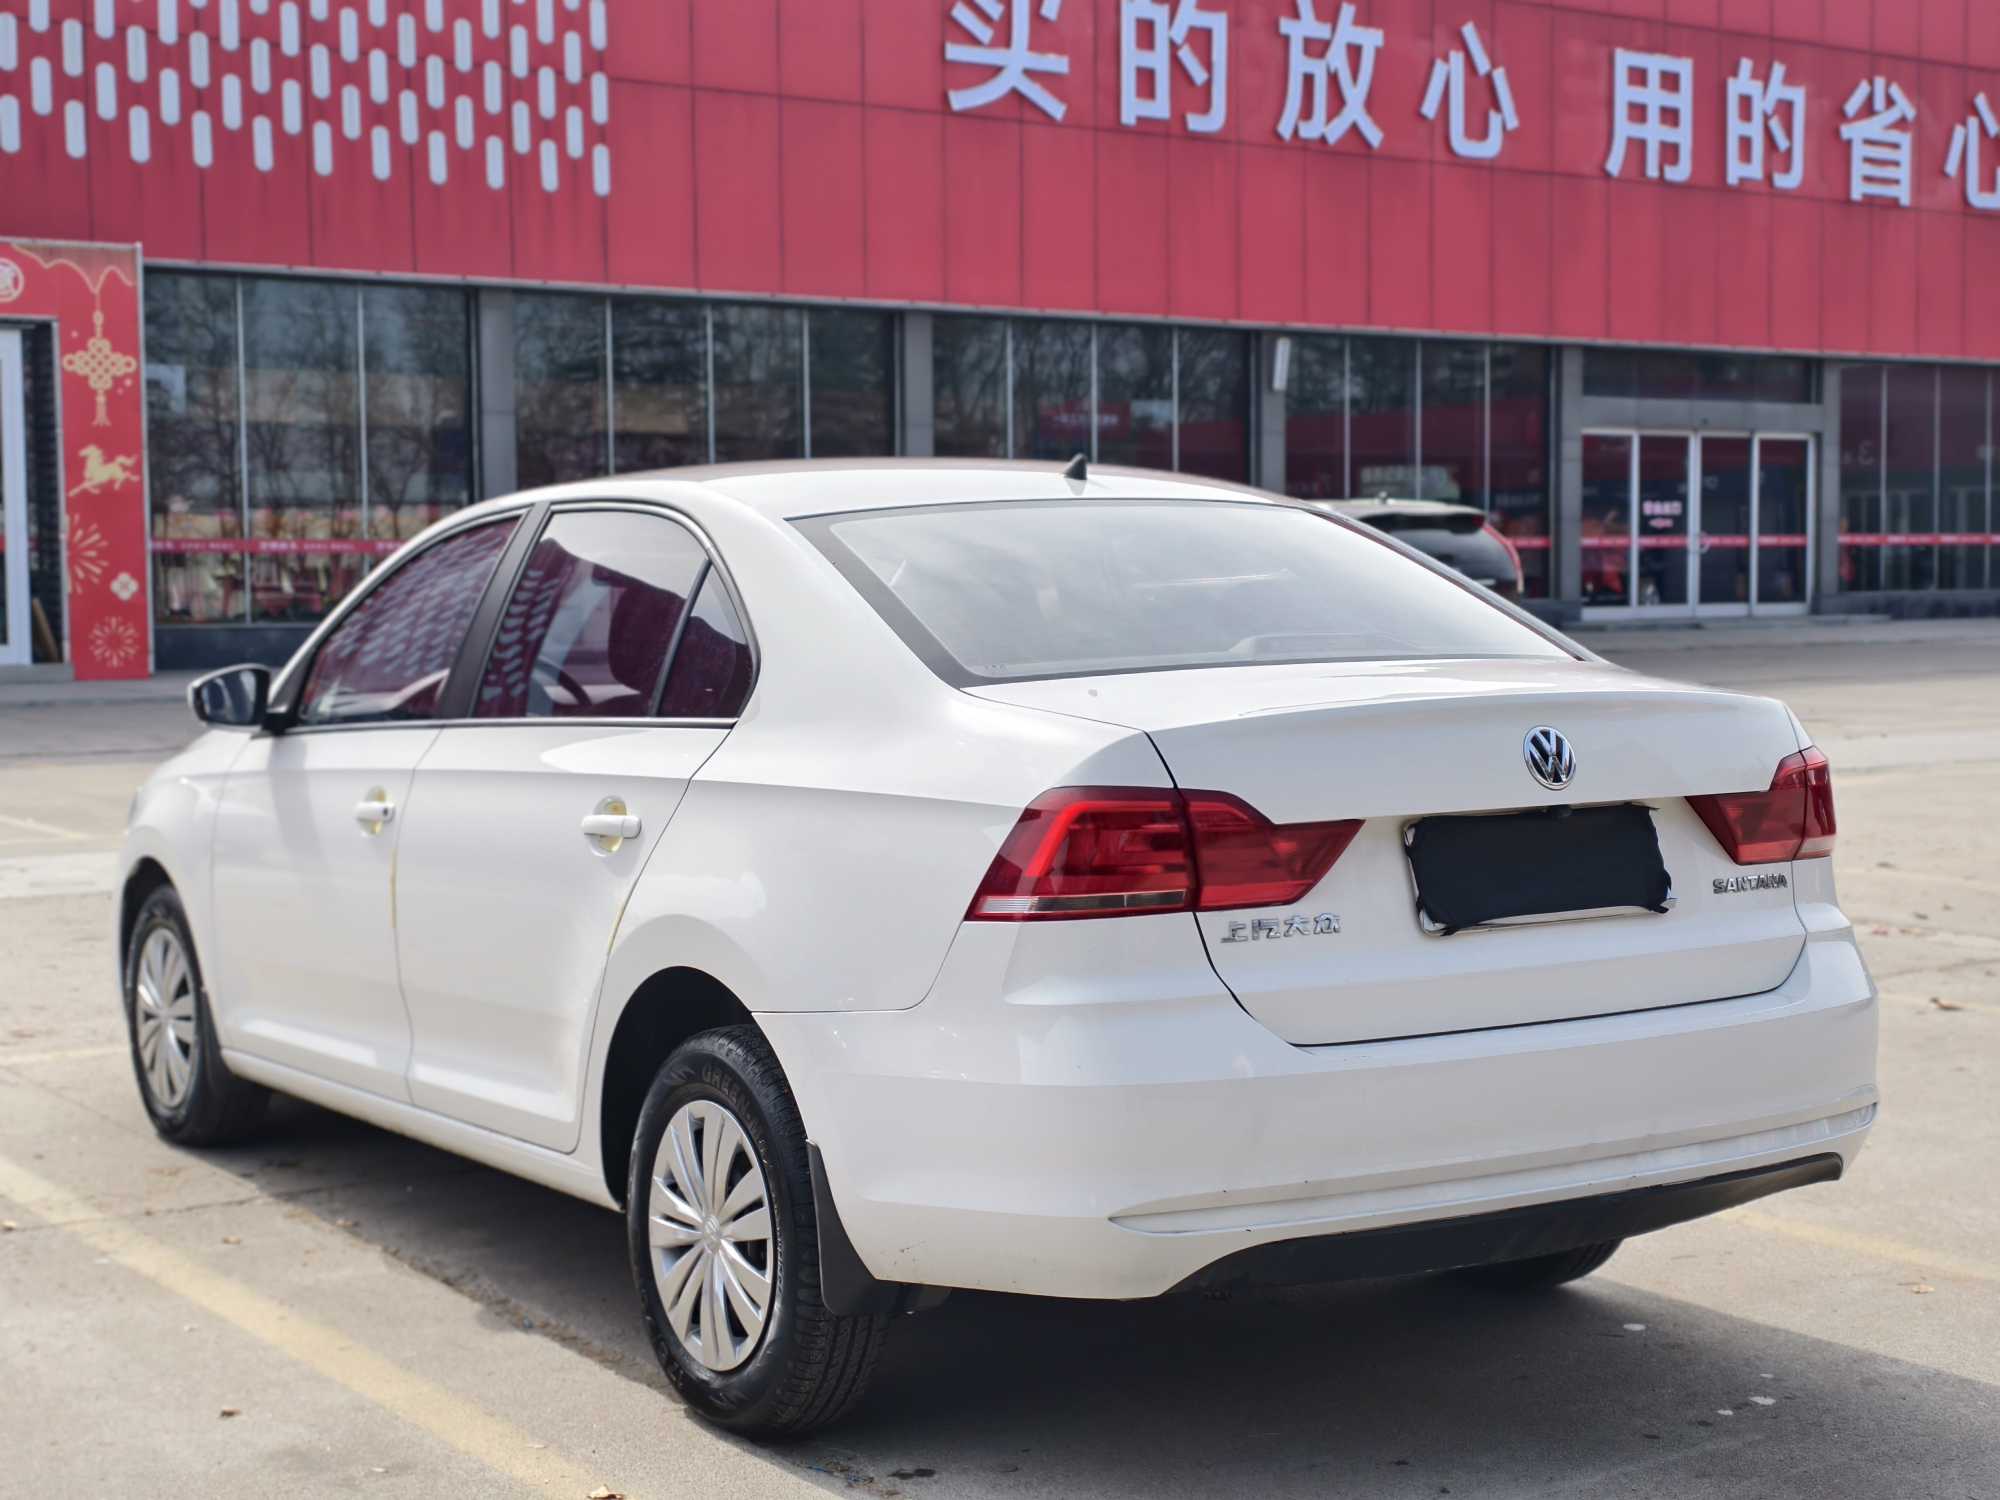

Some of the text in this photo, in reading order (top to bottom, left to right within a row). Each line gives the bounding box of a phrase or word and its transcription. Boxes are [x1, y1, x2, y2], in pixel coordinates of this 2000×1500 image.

[945, 0, 2000, 209] 买的放心 用的省心
[1712, 873, 1788, 894] SANTANA
[1220, 912, 1341, 943] 上汽大众
